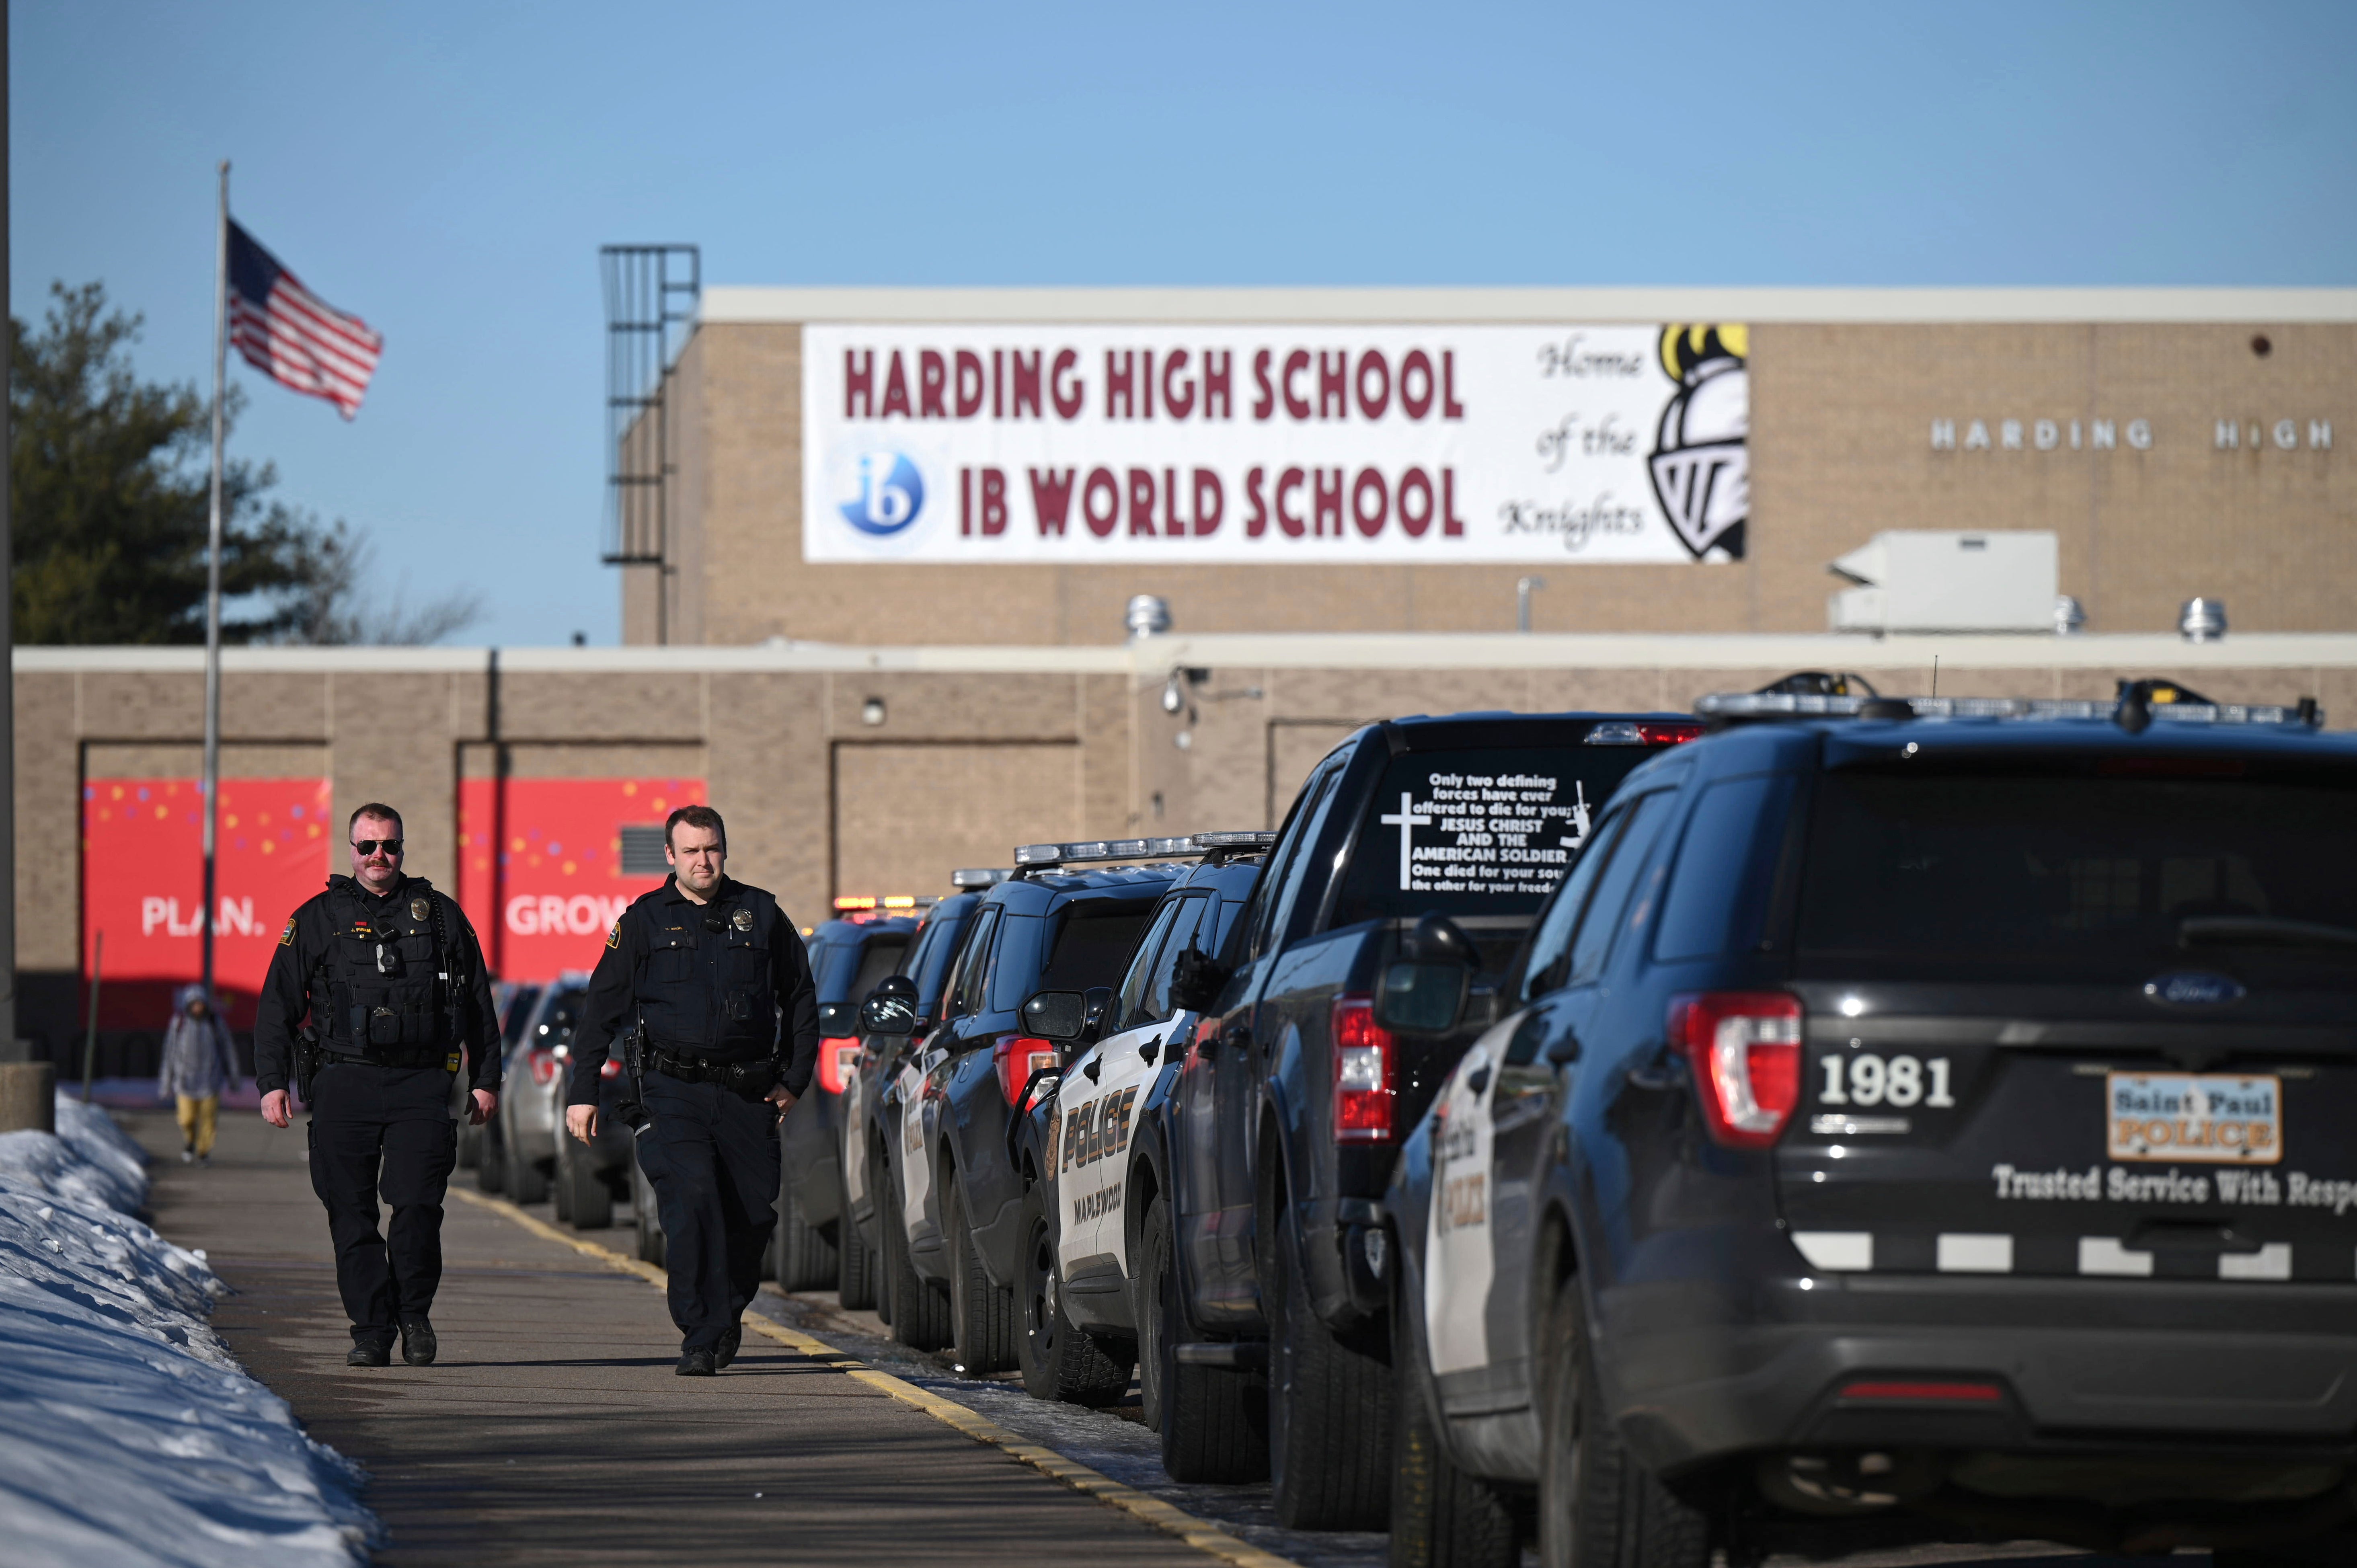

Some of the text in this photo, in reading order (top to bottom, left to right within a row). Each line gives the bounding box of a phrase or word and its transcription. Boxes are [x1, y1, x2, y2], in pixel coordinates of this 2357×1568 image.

[1537, 332, 1644, 378] Home
[845, 348, 1464, 421] HARDING HIGH SCHOOL
[1536, 411, 1637, 474] of the
[1931, 419, 2333, 449] HARDING HIGH
[960, 467, 1464, 538] IB WORLD SCHOOL
[1497, 490, 1645, 552] Knights
[1429, 772, 1557, 791] Only two defining
[1433, 787, 1553, 802] forces have ever
[1413, 800, 1467, 815] offered
[1469, 803, 1486, 815] to
[1488, 802, 1513, 816] die
[1515, 802, 1538, 816] for
[1440, 817, 1544, 833] JESUS CHRIST
[1456, 832, 1528, 847] AND THE
[1411, 846, 1497, 862] AMERICAN
[1411, 863, 1564, 881] One died for your sou
[1411, 879, 1432, 891] the
[1433, 879, 1467, 892] other
[1468, 880, 1488, 892] for
[1488, 883, 1515, 895] your
[1818, 1053, 1956, 1108] 1981
[2116, 1088, 2272, 1115] Saint Paul
[1062, 1084, 1140, 1174] POLICE
[2119, 1119, 2272, 1149] POLICE
[1992, 1164, 2102, 1201] Trusted
[2107, 1166, 2210, 1203] Service
[2215, 1169, 2281, 1205] With
[1074, 1181, 1121, 1226] MAPLEWOOD
